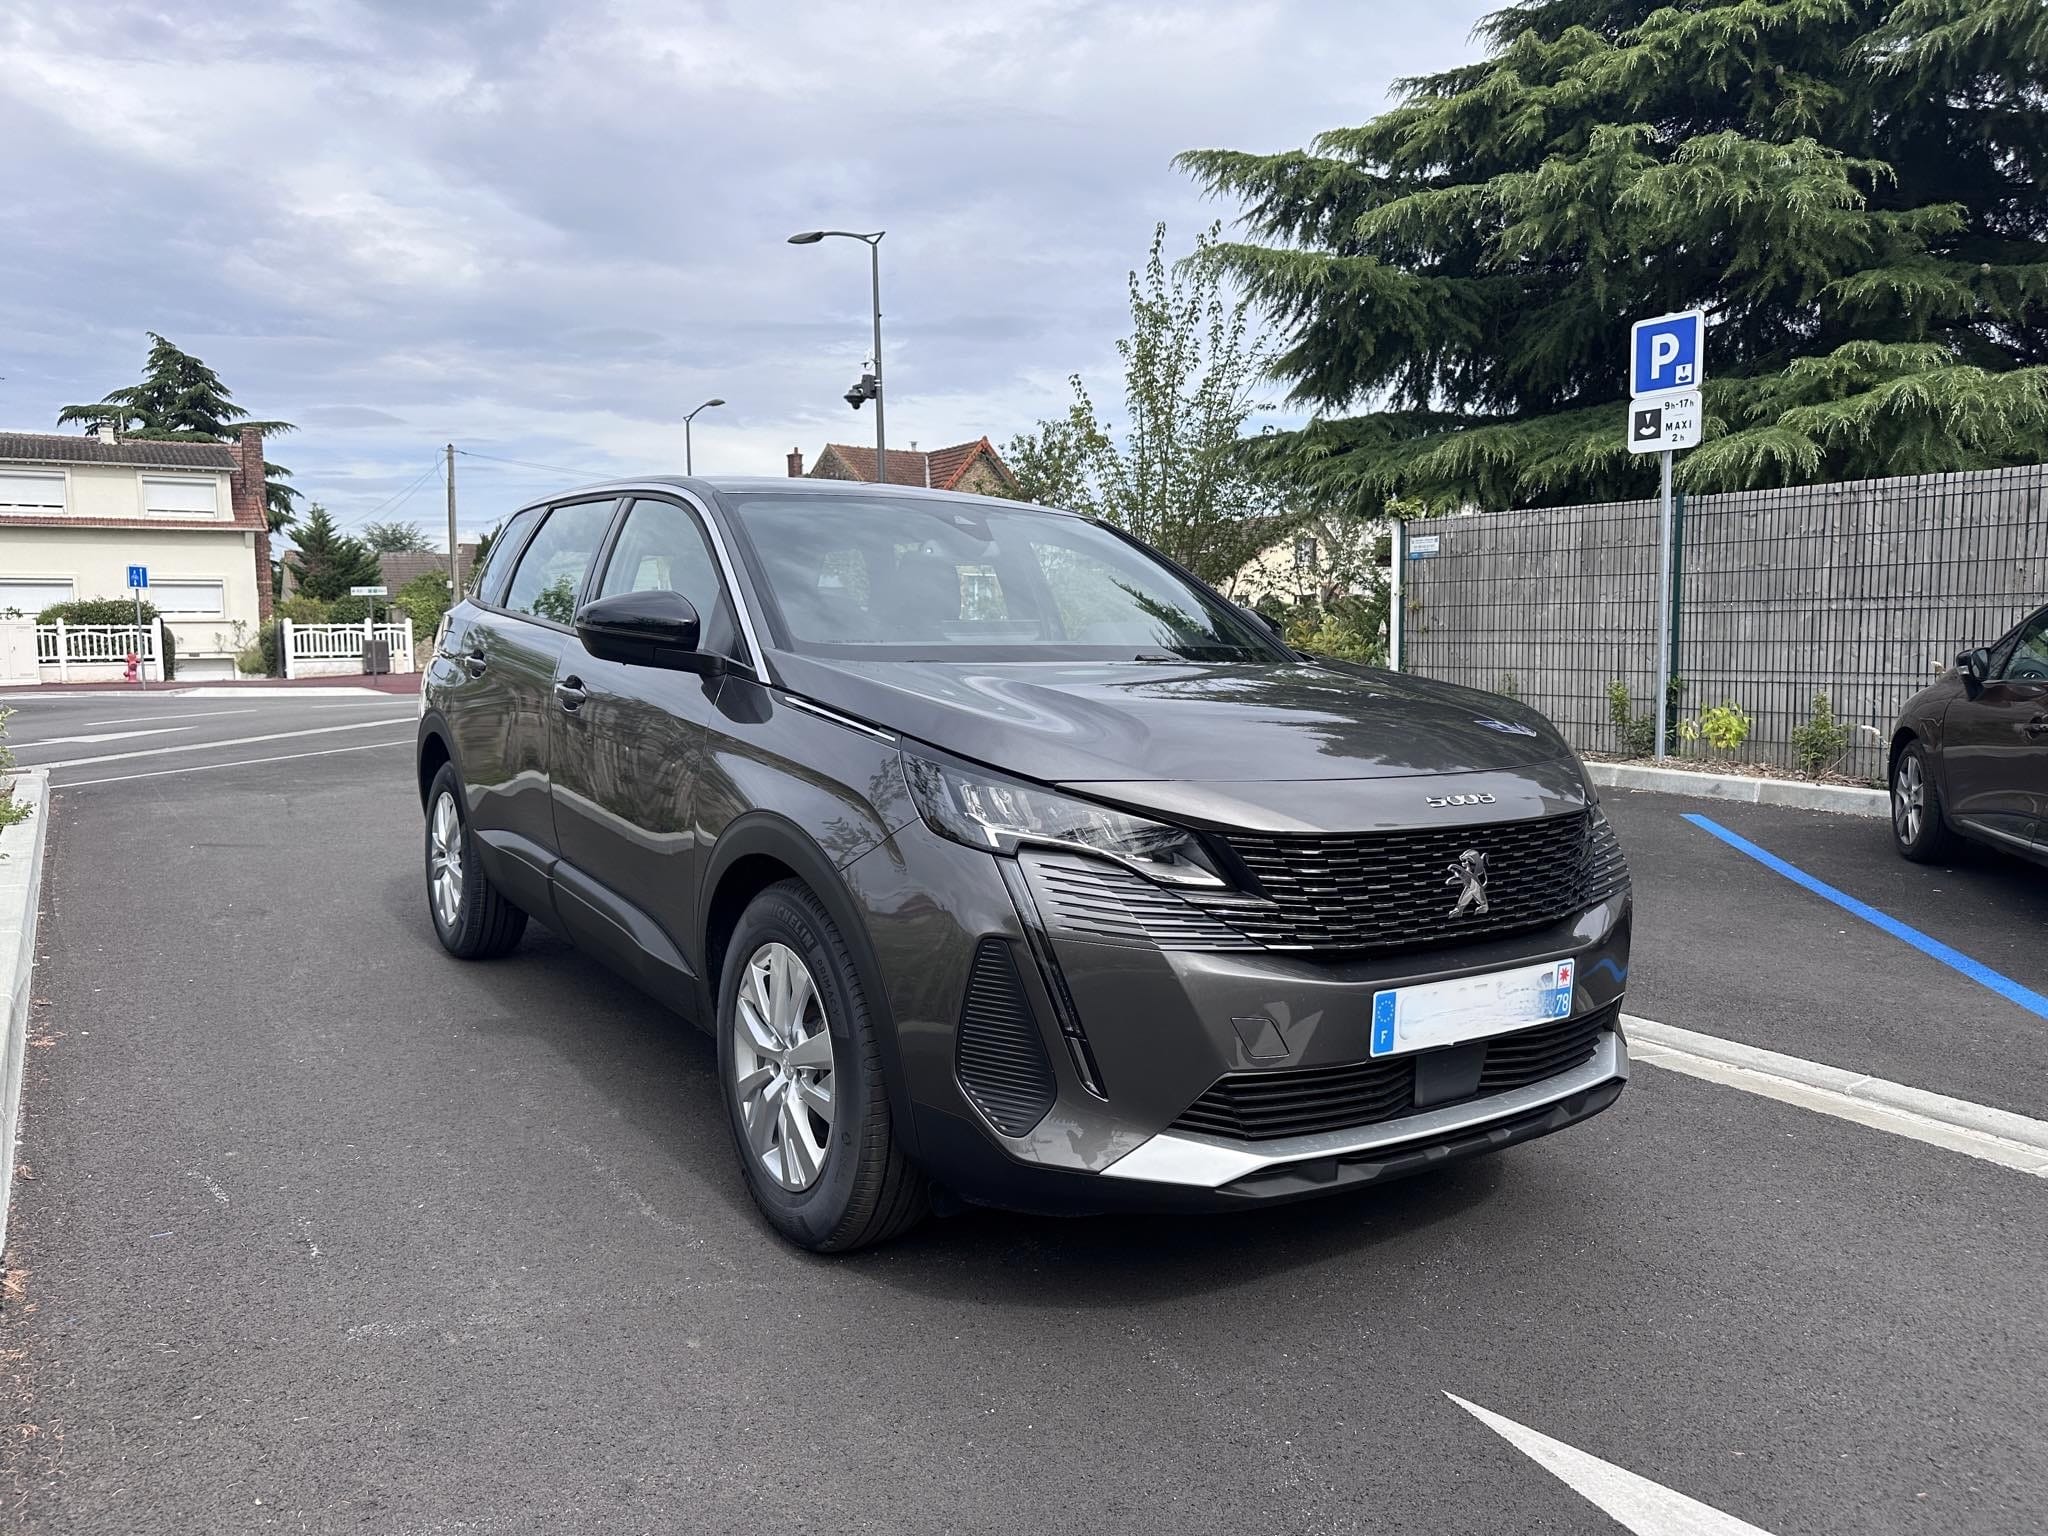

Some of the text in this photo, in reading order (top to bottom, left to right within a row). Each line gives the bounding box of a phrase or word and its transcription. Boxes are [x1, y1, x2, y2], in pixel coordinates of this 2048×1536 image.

[1651, 333, 1680, 380] P
[1665, 420, 1692, 432] MAXI
[1426, 793, 1496, 808] 5008
[1555, 993, 1569, 1013] 78
[1380, 1030, 1388, 1044] F
